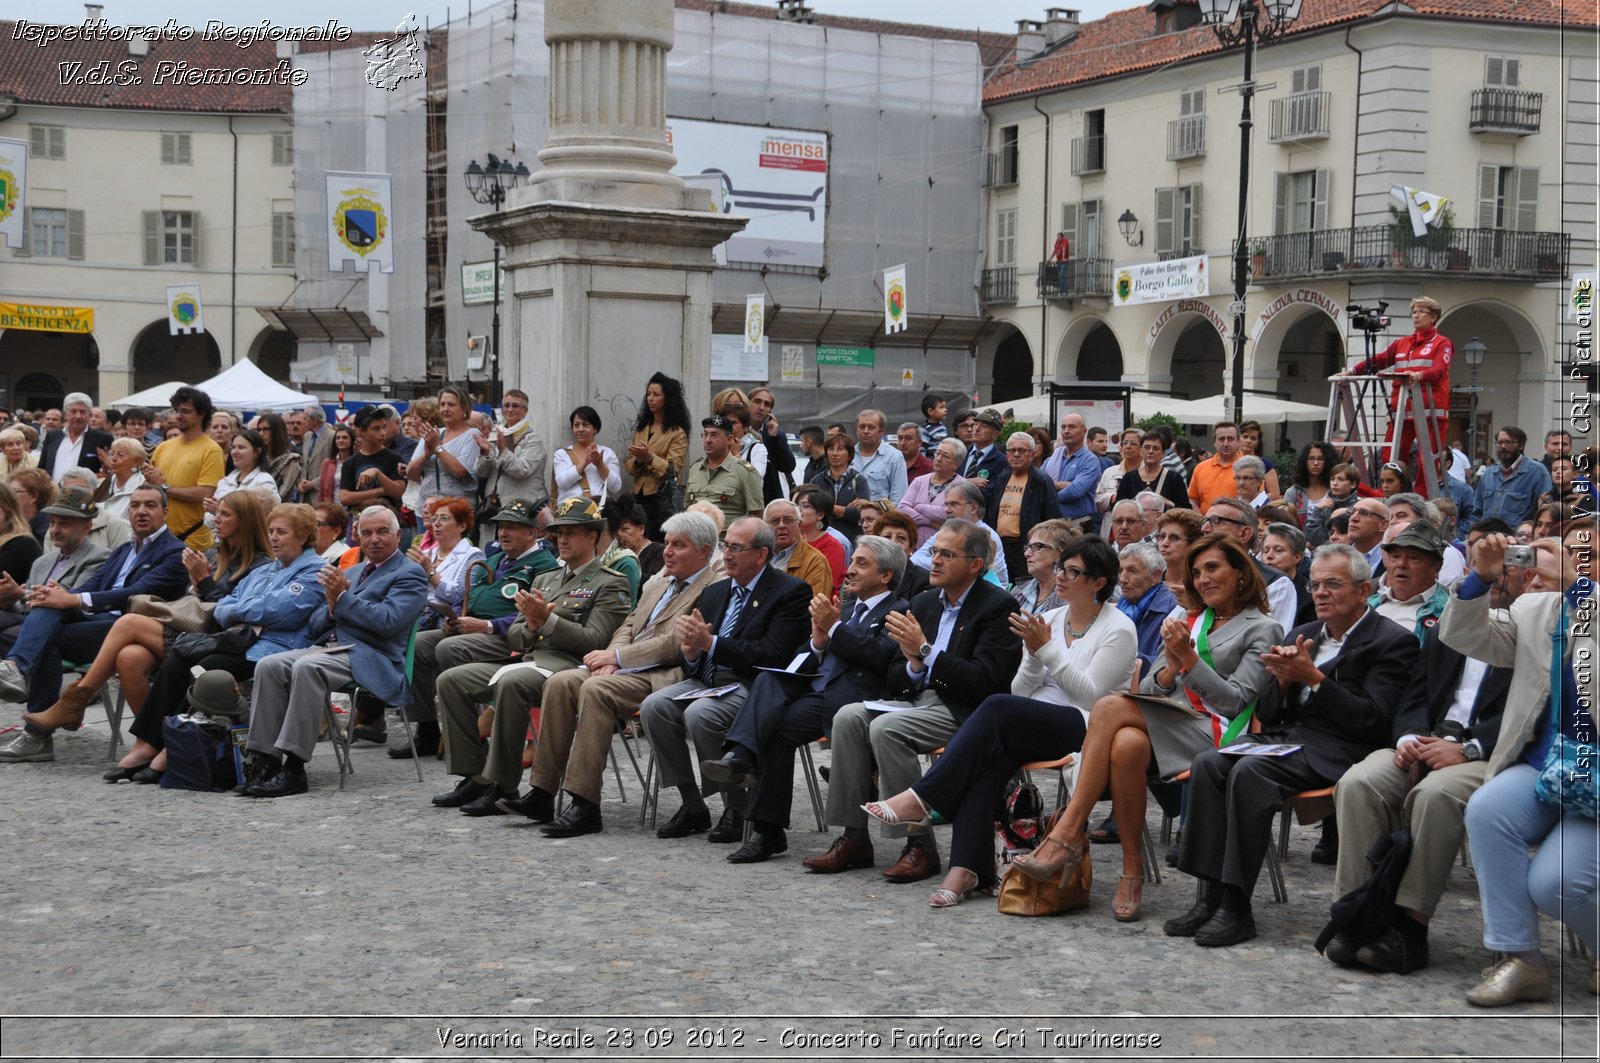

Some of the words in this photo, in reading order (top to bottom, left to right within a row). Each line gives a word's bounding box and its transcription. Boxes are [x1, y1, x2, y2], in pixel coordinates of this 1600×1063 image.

[765, 141, 824, 158] mensa
[1140, 266, 1154, 277] Palio
[1166, 262, 1188, 274] Borghi
[1134, 280, 1164, 293] Borgo
[1167, 273, 1193, 288] Gallo
[17, 305, 58, 316] BANCO
[62, 308, 75, 317] DI
[1261, 292, 1293, 325] NUOVA
[1297, 289, 1340, 320] CERNAIA
[1, 314, 90, 330] BENEFICENZA
[1178, 300, 1228, 335] RISTORANTE
